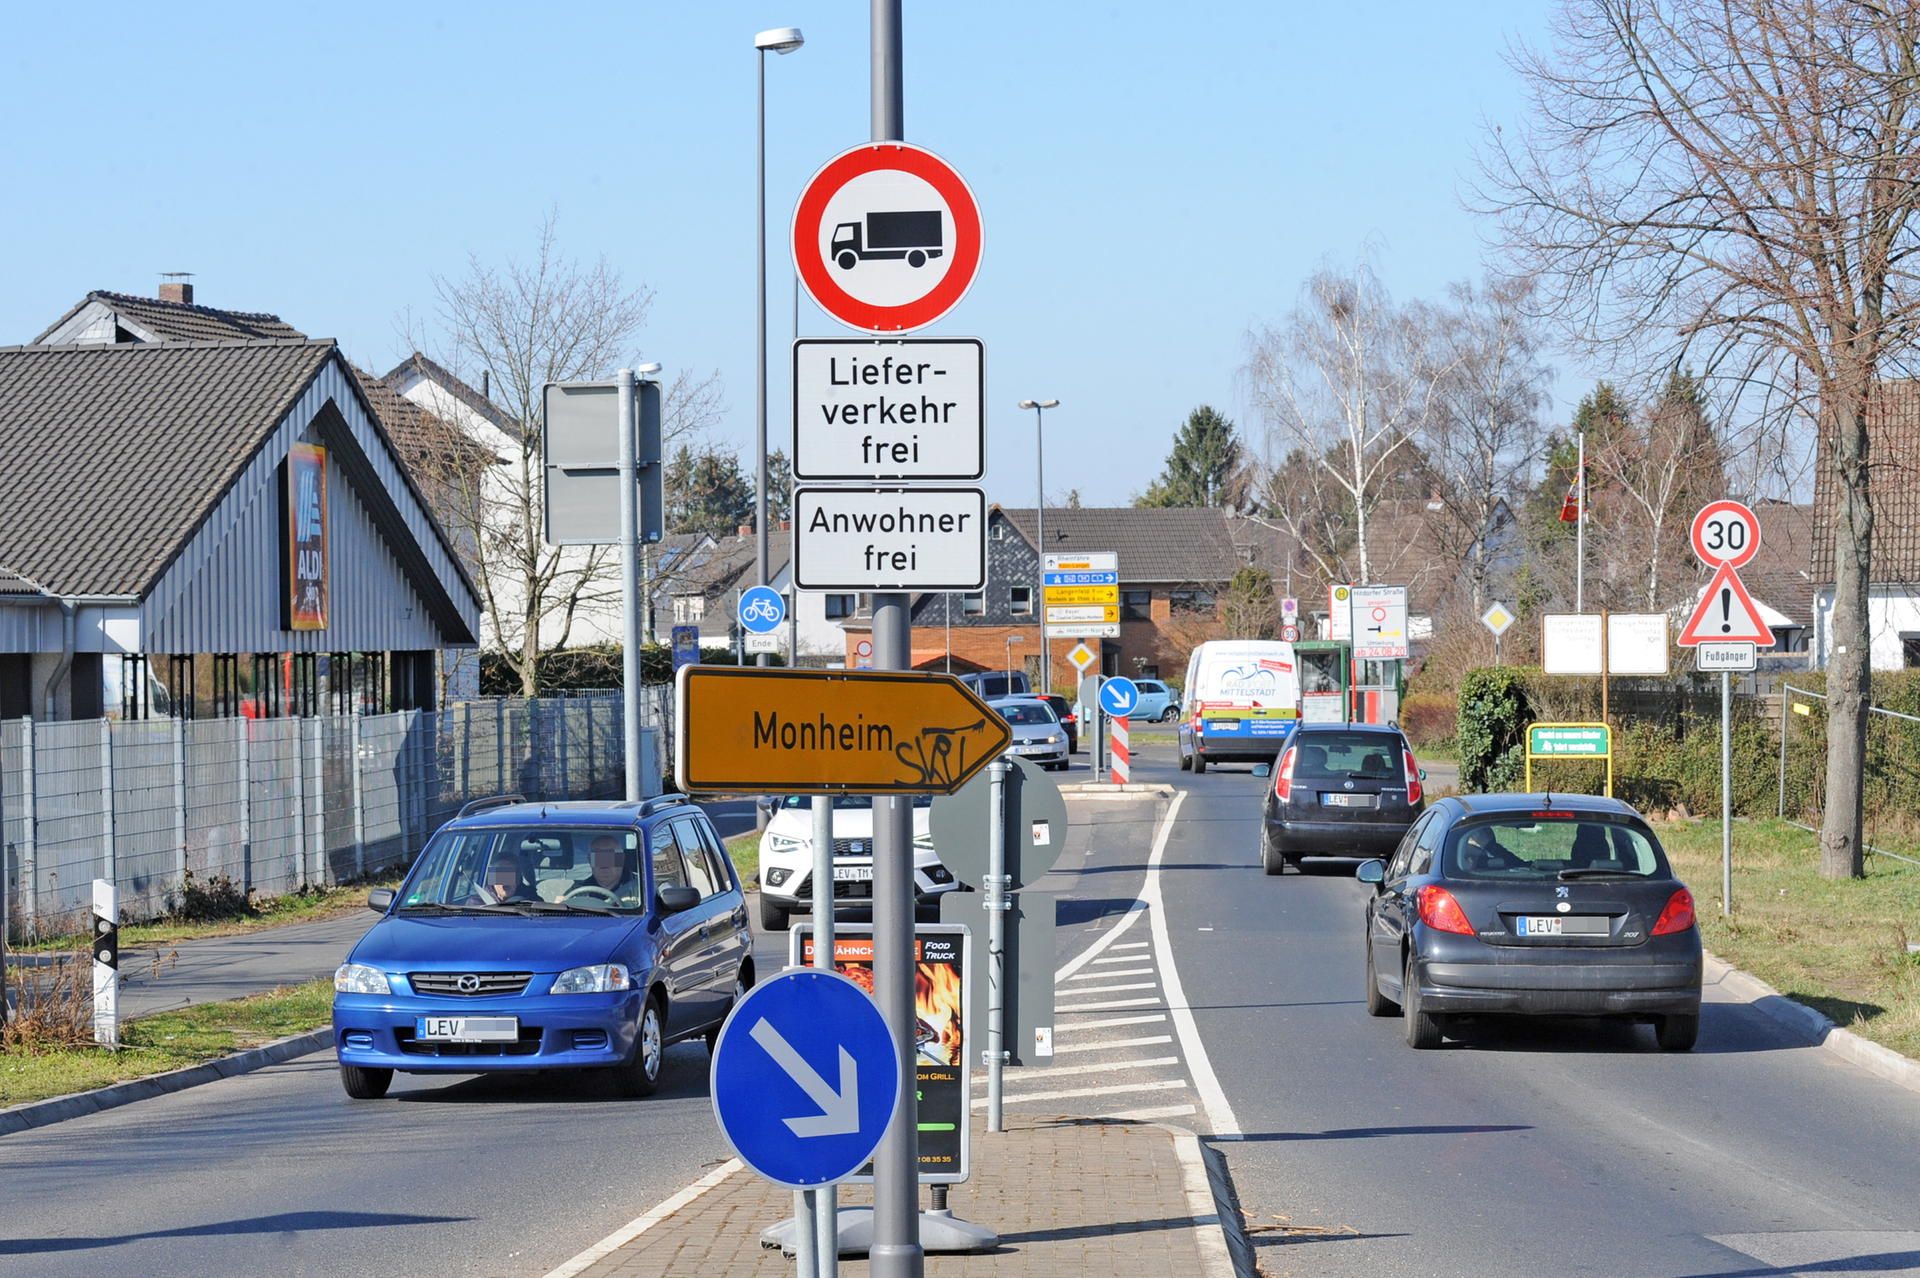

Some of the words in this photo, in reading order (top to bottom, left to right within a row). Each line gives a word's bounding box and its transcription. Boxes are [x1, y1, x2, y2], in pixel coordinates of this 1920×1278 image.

[829, 356, 948, 386] Liefer-
[821, 395, 958, 425] verkehr
[861, 434, 919, 464] frei
[808, 506, 972, 534] Anwohner
[1707, 520, 1745, 550] 30
[297, 550, 323, 580] ALDI
[864, 544, 917, 571] frei
[1285, 629, 1295, 639] 30
[752, 640, 772, 648] Ende
[1705, 650, 1747, 663] Fußgänger
[753, 711, 893, 751] Monheim
[856, 868, 869, 878] TM
[1528, 917, 1553, 933] LEV
[1623, 931, 1640, 939] 207
[924, 941, 951, 950] FOOD
[925, 951, 956, 961] TRUCK
[427, 1020, 458, 1035] LEV
